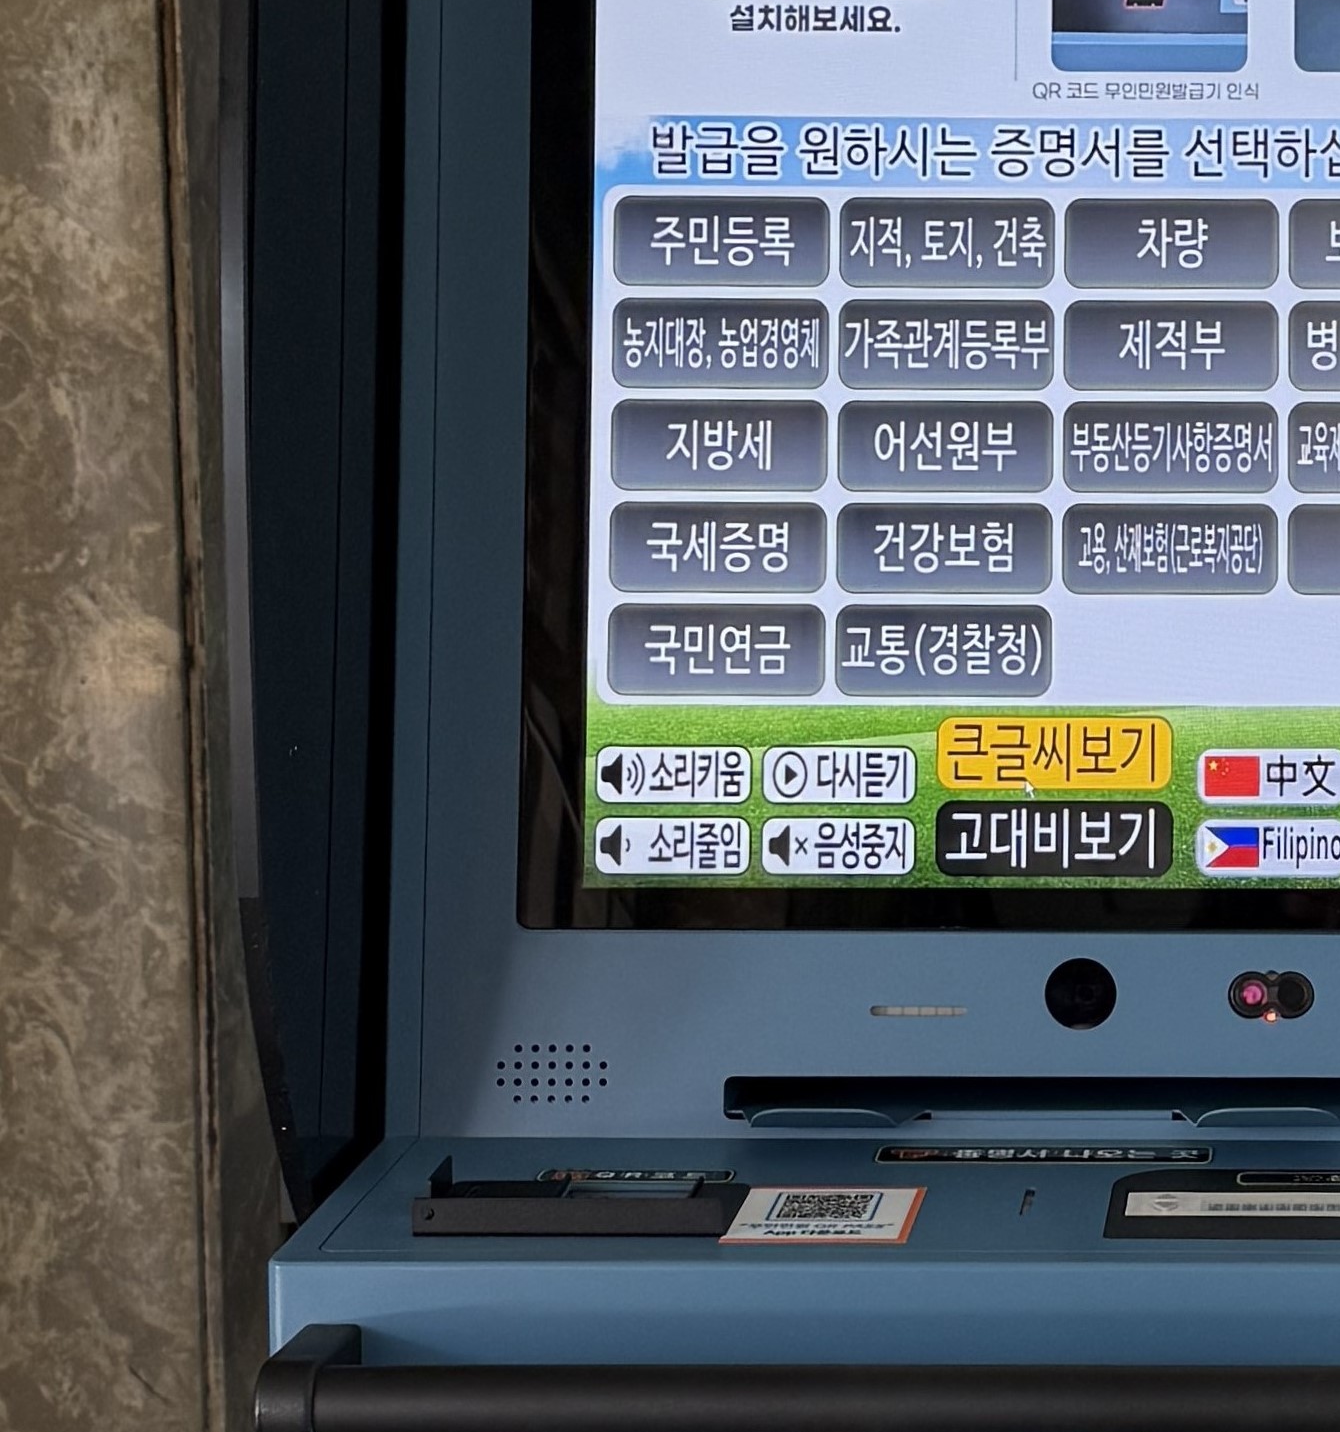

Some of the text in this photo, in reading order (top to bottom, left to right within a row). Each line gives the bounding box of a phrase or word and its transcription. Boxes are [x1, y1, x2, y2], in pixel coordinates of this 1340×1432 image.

[730, 4, 901, 33] 설치해보세요.
[1032, 82, 1259, 101] QR 코드 무인민원발급기 인식
[651, 123, 785, 177] 발급을
[799, 123, 978, 178] 원하시는
[991, 126, 1170, 178] 증명서를
[650, 215, 796, 267] 주민등록
[850, 216, 1047, 269] 지적, 토지, 건축
[1136, 217, 1209, 268] 차량
[623, 317, 819, 369] 농지대장, 농업경영체
[844, 318, 1050, 370] 가족관계등록부
[1119, 319, 1226, 371] 제적부
[666, 419, 773, 471] 지방세
[874, 420, 1017, 472] 어선원부
[1070, 421, 1273, 474] 부동산등기사항증명서
[646, 521, 789, 573] 국세증명
[873, 522, 1014, 573] 건강보험
[1079, 522, 1263, 575] 고용, 산재보험(근로복지공단)
[645, 624, 791, 676] 국민연금
[841, 623, 1042, 677] 교통(경찰청)
[650, 750, 744, 798] 소리키움
[817, 751, 907, 798] 다시듣기
[947, 723, 1155, 782] 큰글씨보기
[1266, 754, 1336, 797] 中文
[648, 820, 741, 869] 소리줄임
[814, 822, 906, 869] 음성중지
[945, 808, 1155, 869] 고대비보기
